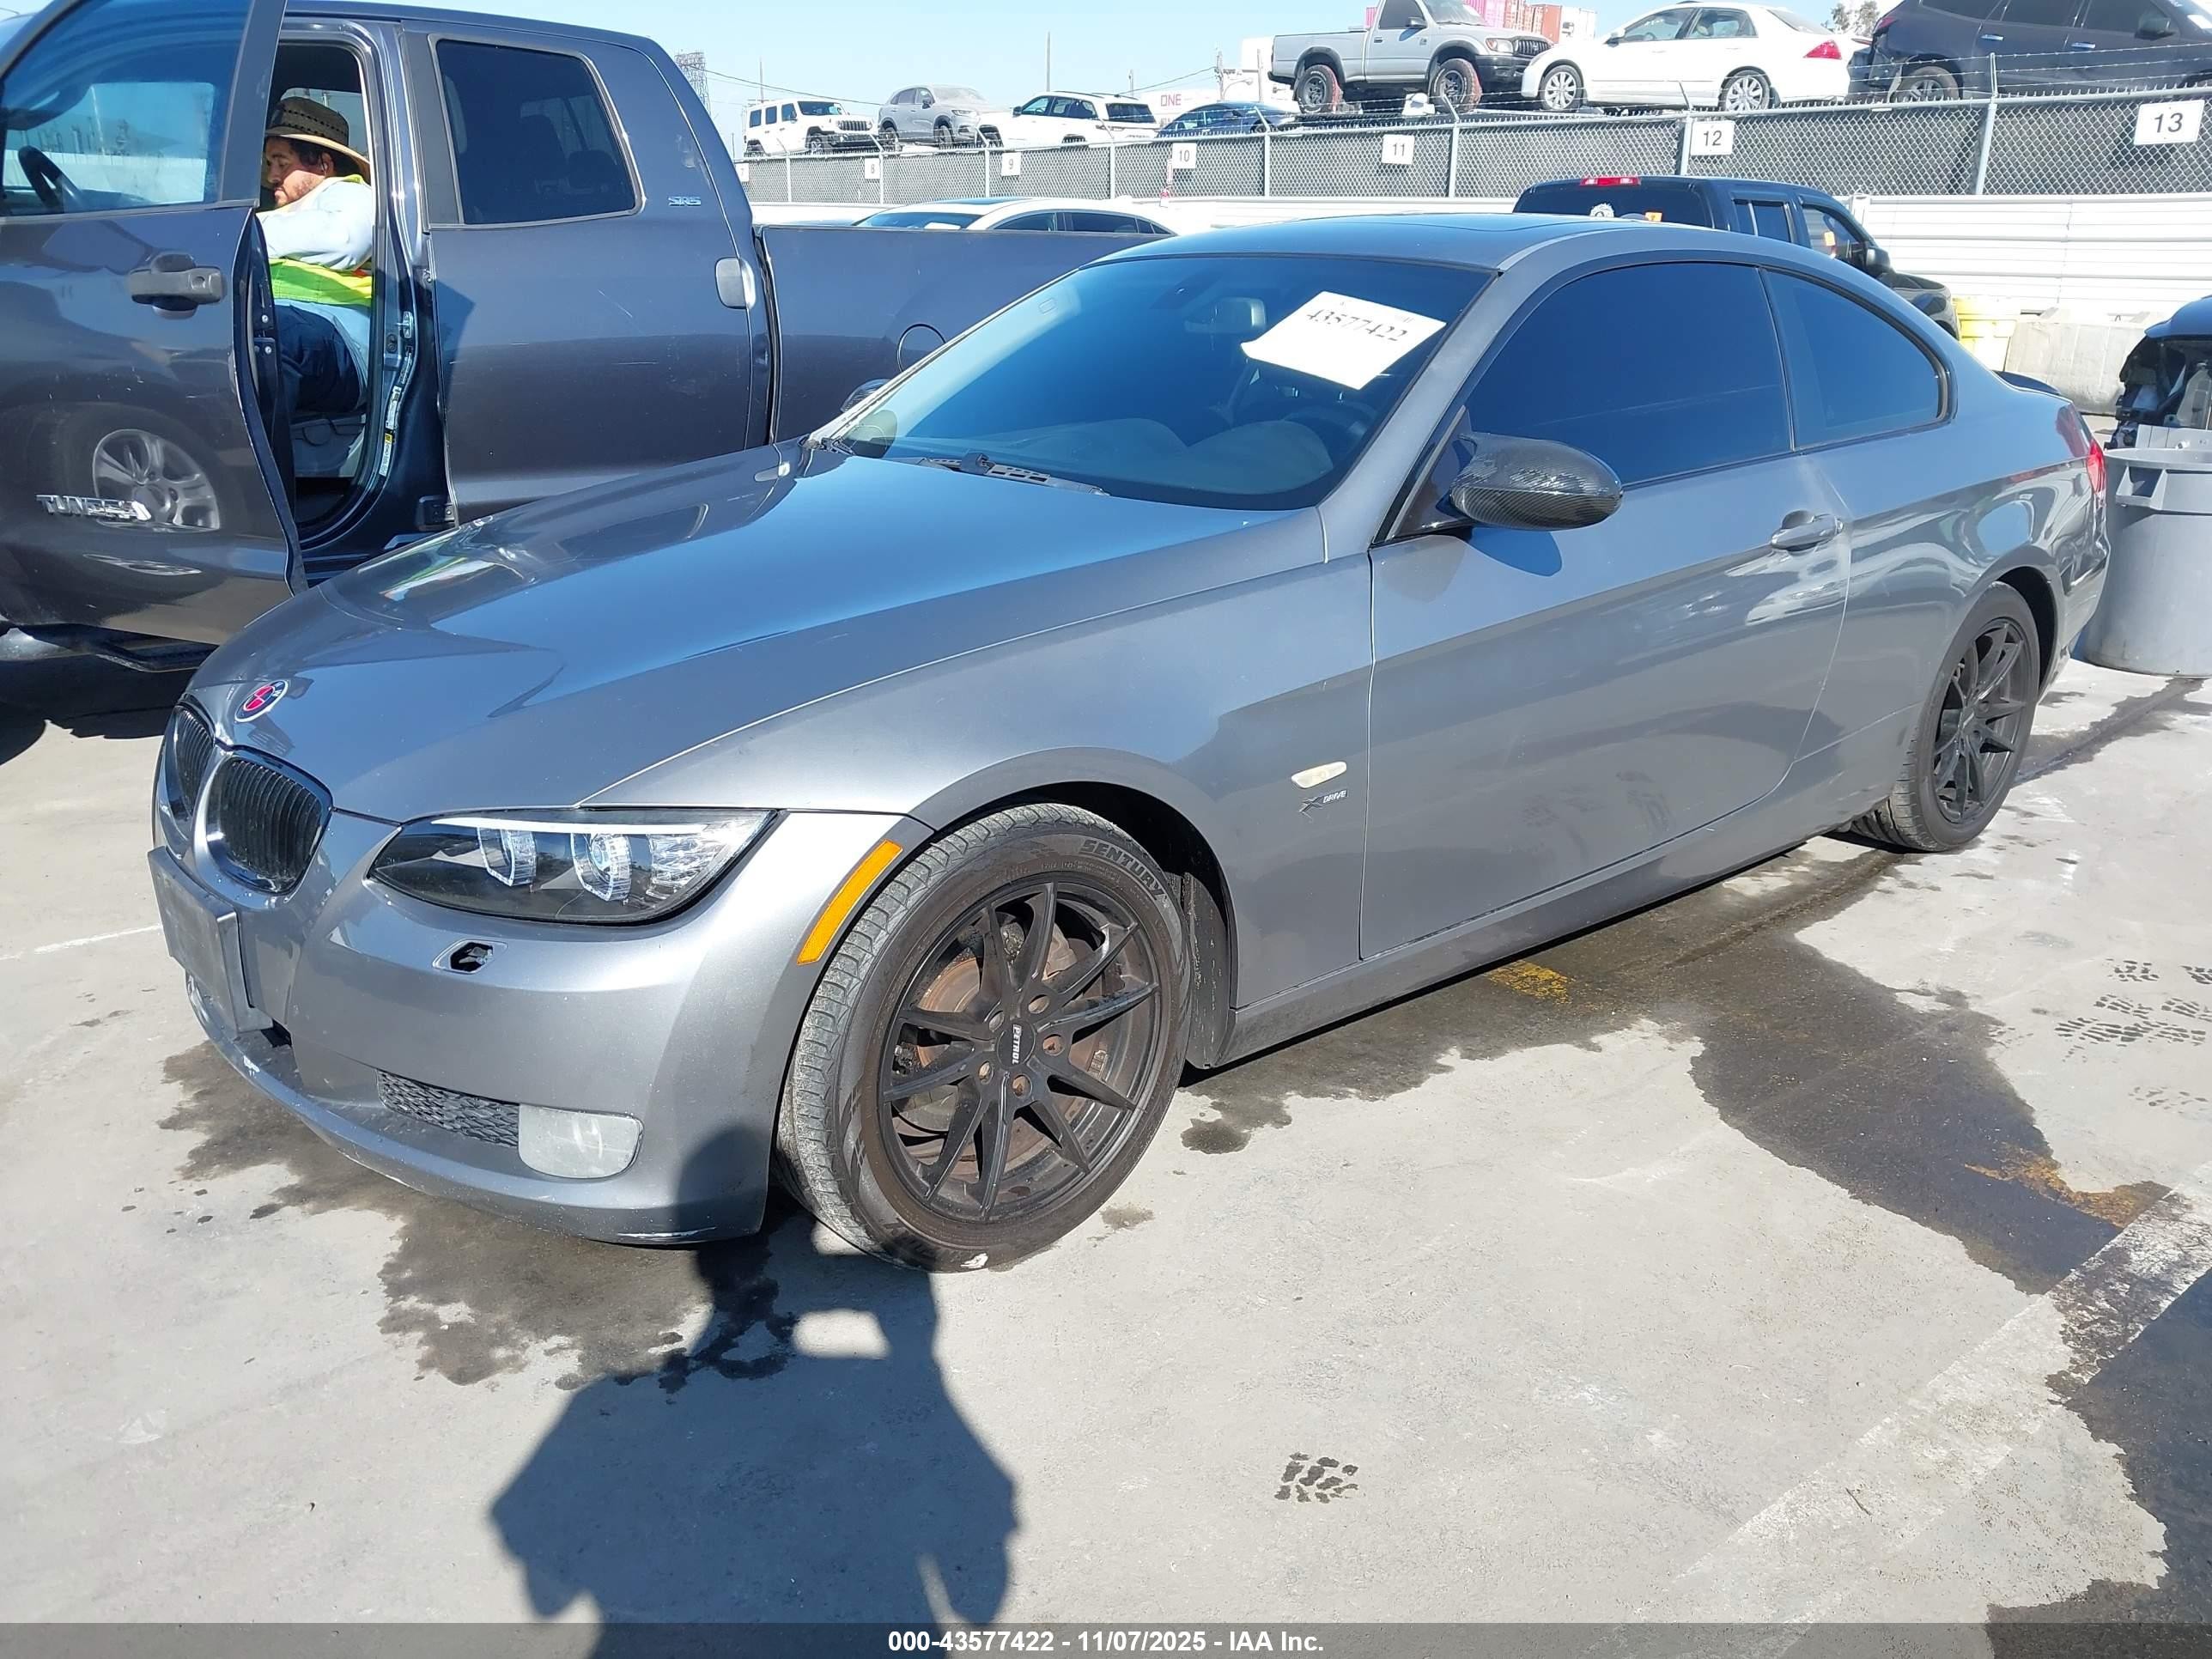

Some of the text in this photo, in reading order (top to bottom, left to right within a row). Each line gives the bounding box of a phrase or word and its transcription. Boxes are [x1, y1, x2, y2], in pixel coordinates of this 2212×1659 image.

[1160, 94, 1182, 106] ONE
[2154, 112, 2184, 133] 13
[1703, 130, 1722, 146] 12
[1179, 149, 1190, 161] 10
[1392, 143, 1405, 155] 11
[871, 163, 875, 174] 8
[1008, 158, 1014, 170] 9
[1080, 839, 1168, 901] SENTURY
[1012, 1024, 1022, 1065] PETROL
